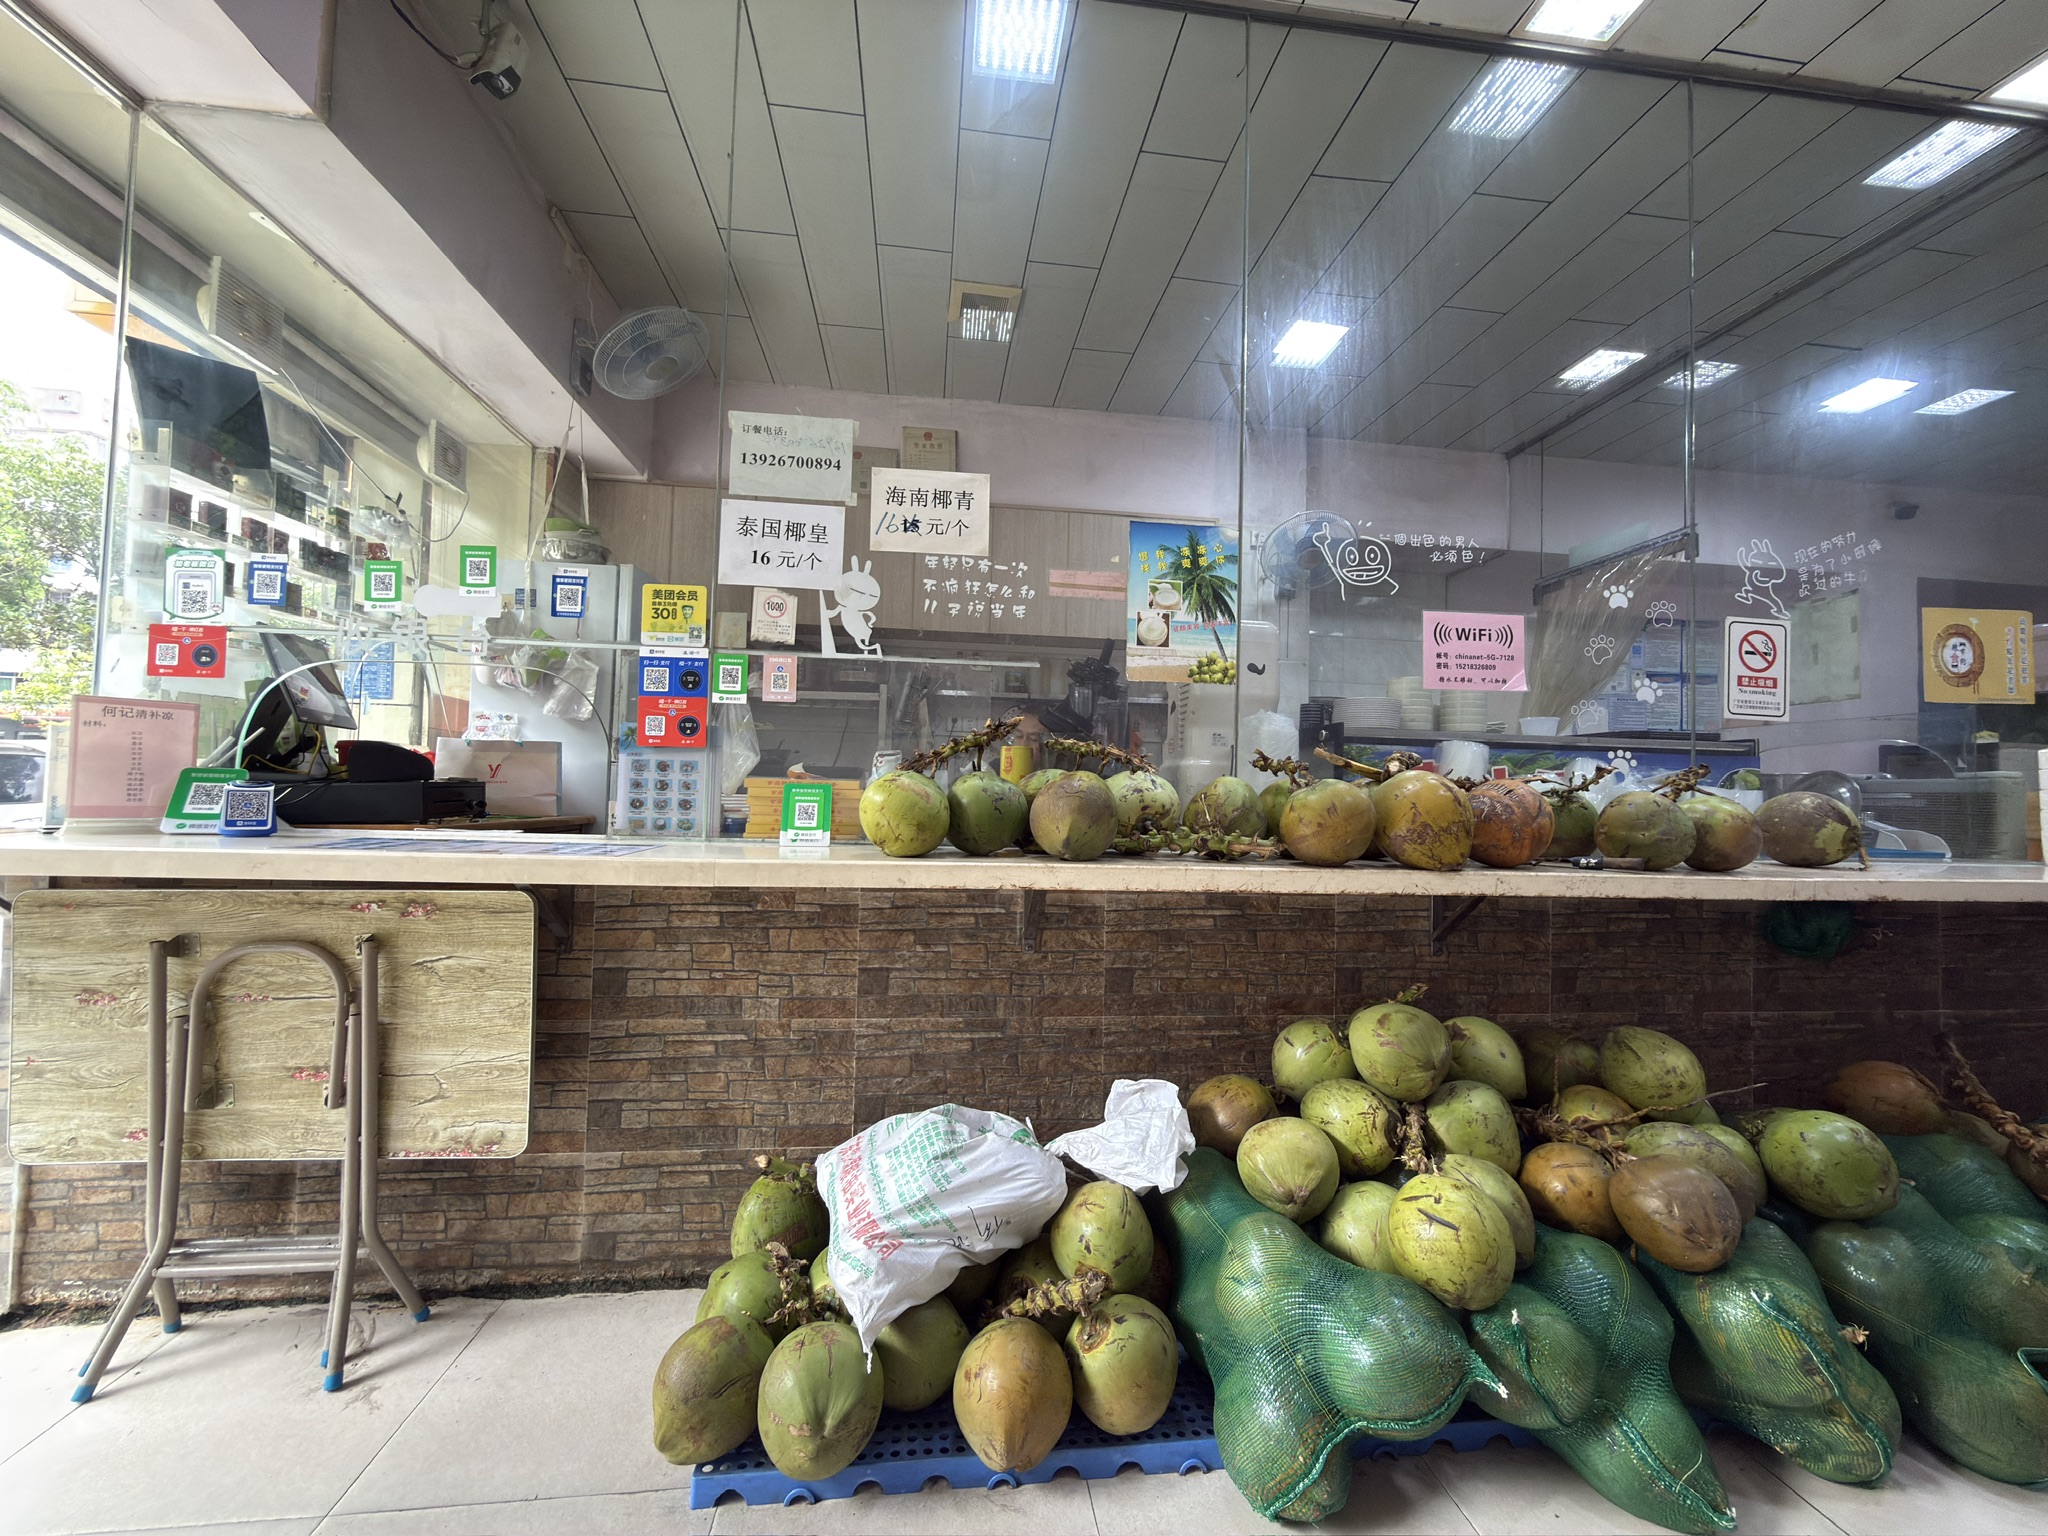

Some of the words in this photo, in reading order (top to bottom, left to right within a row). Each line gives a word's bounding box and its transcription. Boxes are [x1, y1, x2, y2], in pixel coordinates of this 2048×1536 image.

[740, 452, 842, 471] 13926700894
[885, 485, 975, 510] 海南椰青
[736, 515, 829, 544] 泰国椰皇
[925, 516, 970, 537] 元/个
[750, 550, 771, 565] 16
[775, 551, 823, 570] 元/个
[924, 555, 1029, 578] 年轻只有一次
[652, 589, 698, 601] 美团会员
[923, 578, 1036, 599] 不疯狂怎么和
[651, 608, 671, 620] 30
[924, 599, 1027, 619] 儿子说当年
[336, 617, 491, 656] 收银台
[1455, 627, 1492, 642] WiFi
[1455, 663, 1497, 671] 15218326809
[1741, 677, 1774, 687] 禁止吸烟
[1748, 689, 1777, 697] smoking
[102, 705, 175, 721] 何记清补凉
